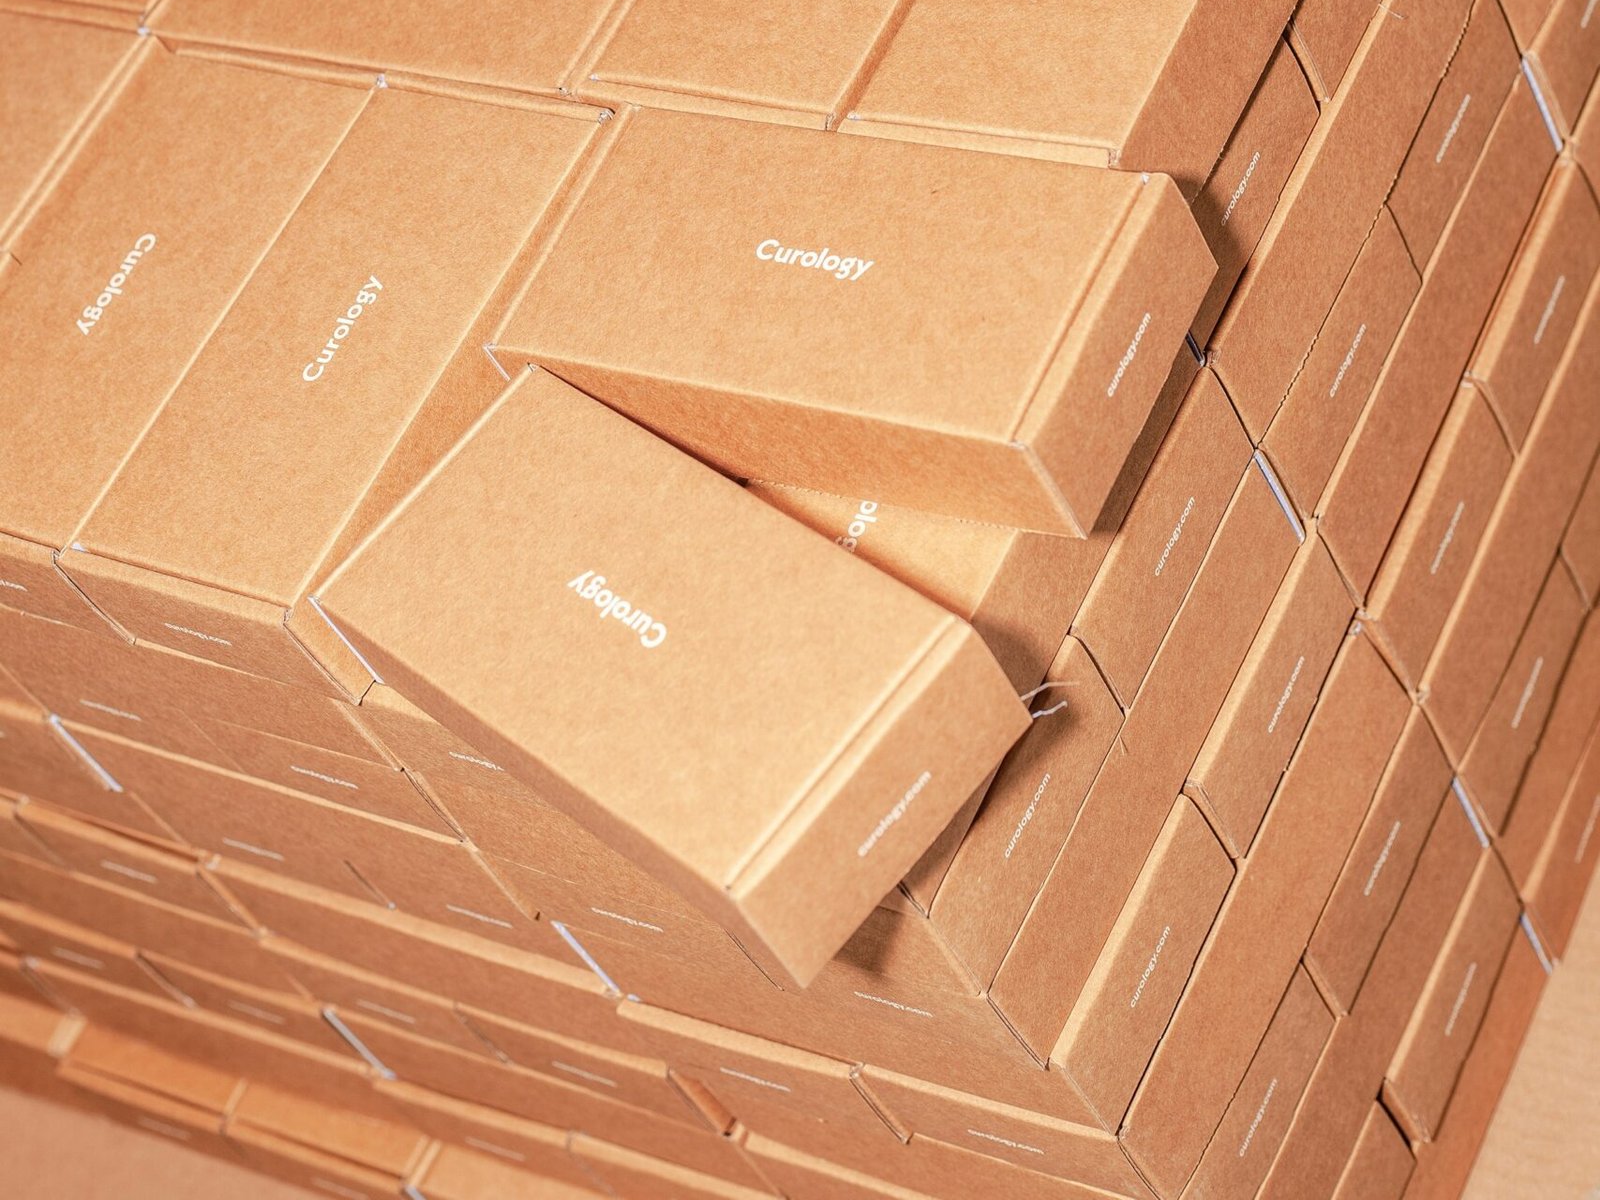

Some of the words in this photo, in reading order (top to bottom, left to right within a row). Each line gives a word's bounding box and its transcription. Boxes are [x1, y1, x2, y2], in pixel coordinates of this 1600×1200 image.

[1221, 151, 1260, 227] curology.com
[77, 234, 156, 335] Curology
[756, 239, 874, 281] Curology
[302, 275, 383, 381] Curology
[1107, 313, 1151, 397] curology.com
[1329, 323, 1367, 398] curology.com
[834, 499, 879, 554] olog
[1154, 496, 1196, 577] curology.com
[567, 571, 667, 648] Curology
[857, 770, 932, 858] curology.com
[1004, 773, 1051, 859] curology.com
[1129, 925, 1171, 1009] curology.com
